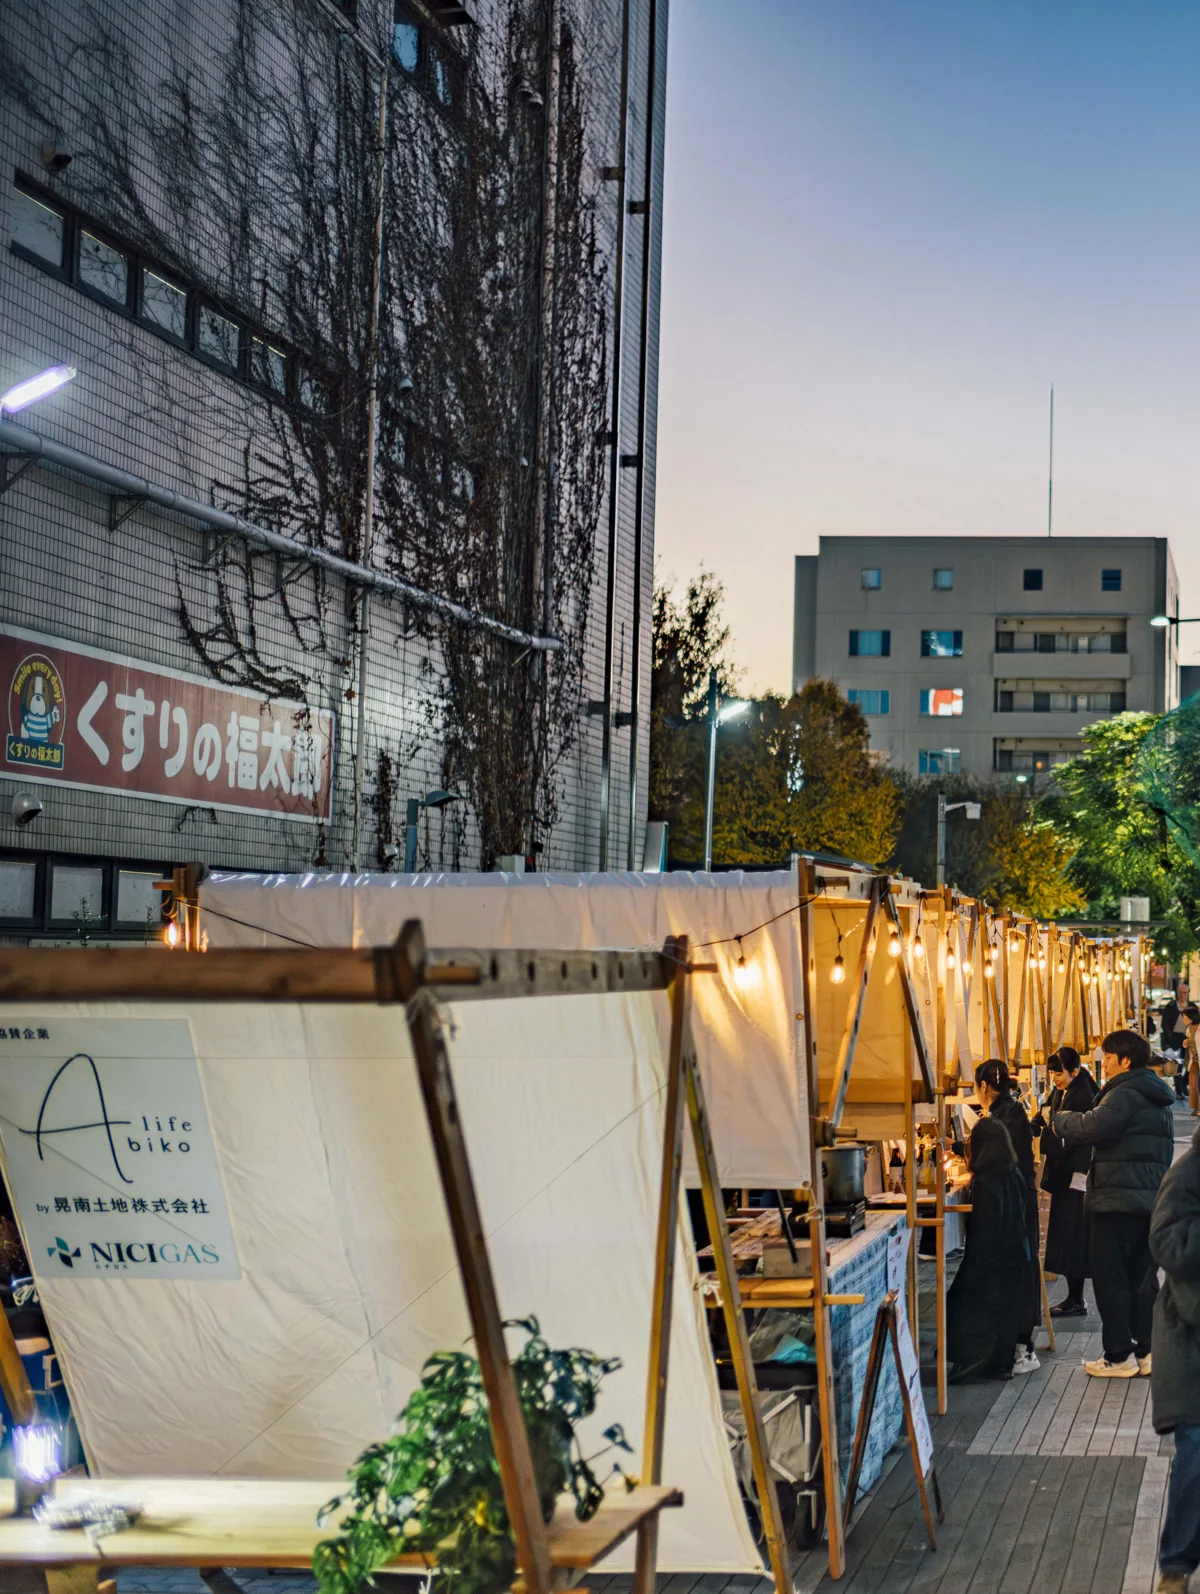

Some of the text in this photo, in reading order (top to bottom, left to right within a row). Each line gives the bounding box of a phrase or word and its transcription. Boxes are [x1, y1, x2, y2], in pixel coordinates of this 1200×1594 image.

[14, 661, 63, 703] Smile every day!
[77, 681, 323, 800] くすりの福太郎
[9, 742, 61, 763] くすりの福太郎
[19, 1053, 193, 1183] A life
[128, 1137, 191, 1153] biko
[36, 1197, 210, 1214] by 晃南土地株式会社
[89, 1242, 220, 1264] NICIGAS
